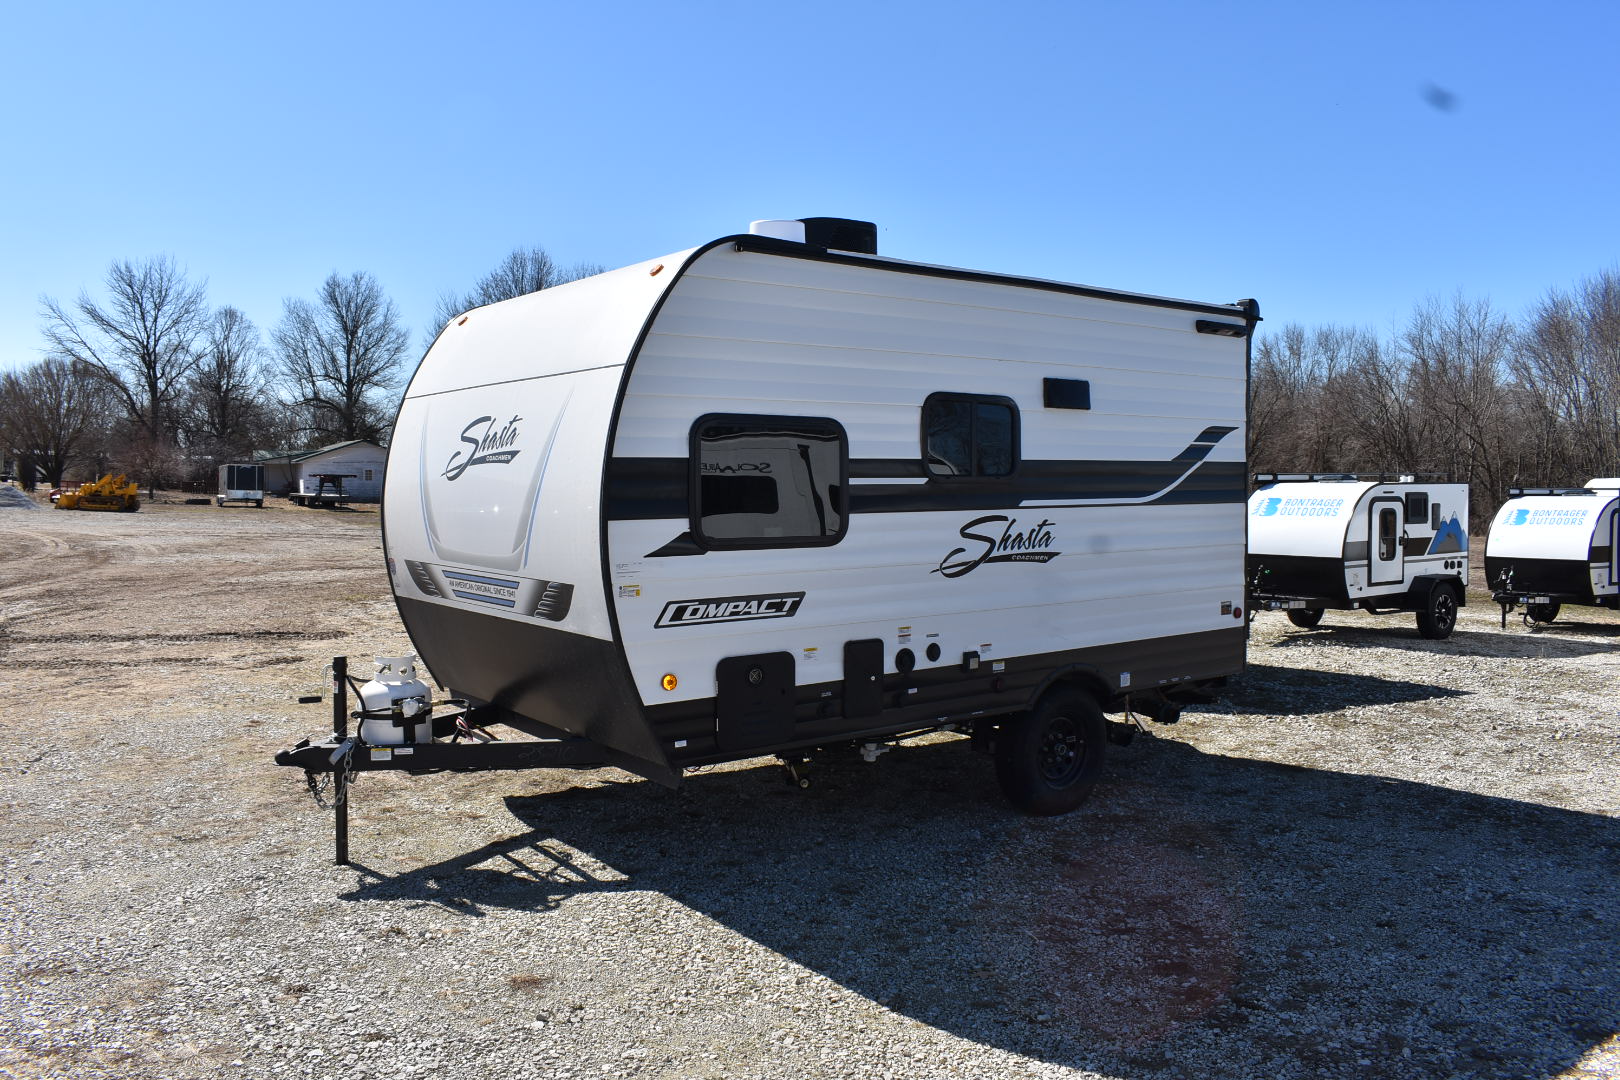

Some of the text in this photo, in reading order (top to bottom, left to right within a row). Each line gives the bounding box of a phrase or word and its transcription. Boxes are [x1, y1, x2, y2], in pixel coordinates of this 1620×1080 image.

[440, 414, 523, 481] Shasta
[1284, 498, 1344, 508] BONTRAGER
[1280, 507, 1339, 517] OUTDOORS
[1532, 509, 1588, 517] BONTRAGER
[1529, 517, 1584, 525] OUTDOORS
[929, 514, 1057, 578] Shasta
[658, 597, 801, 626] COMPACT
